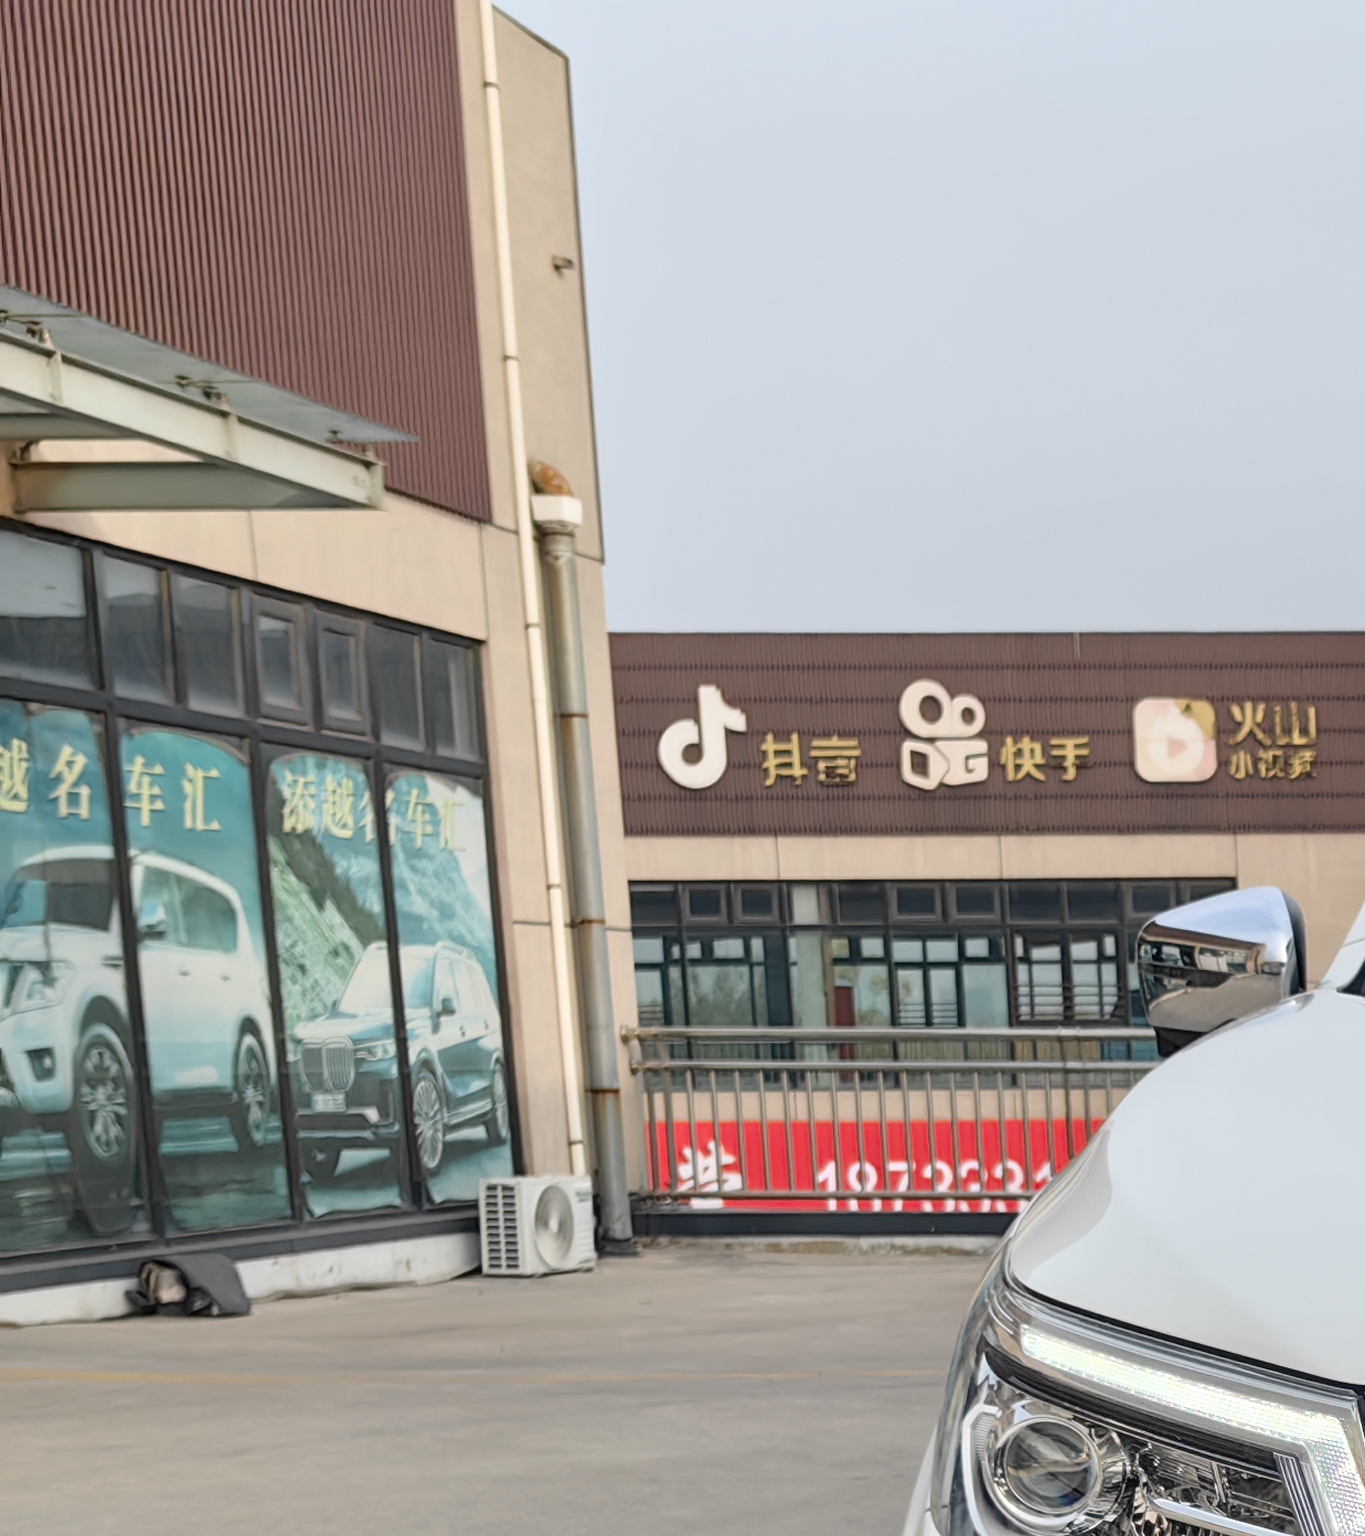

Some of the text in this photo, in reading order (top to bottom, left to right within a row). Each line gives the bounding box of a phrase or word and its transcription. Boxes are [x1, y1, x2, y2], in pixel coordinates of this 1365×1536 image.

[1227, 701, 1317, 747] 火山
[760, 731, 861, 788] 抖音
[1000, 735, 1091, 782] 快手
[1229, 750, 1318, 780] 小视频
